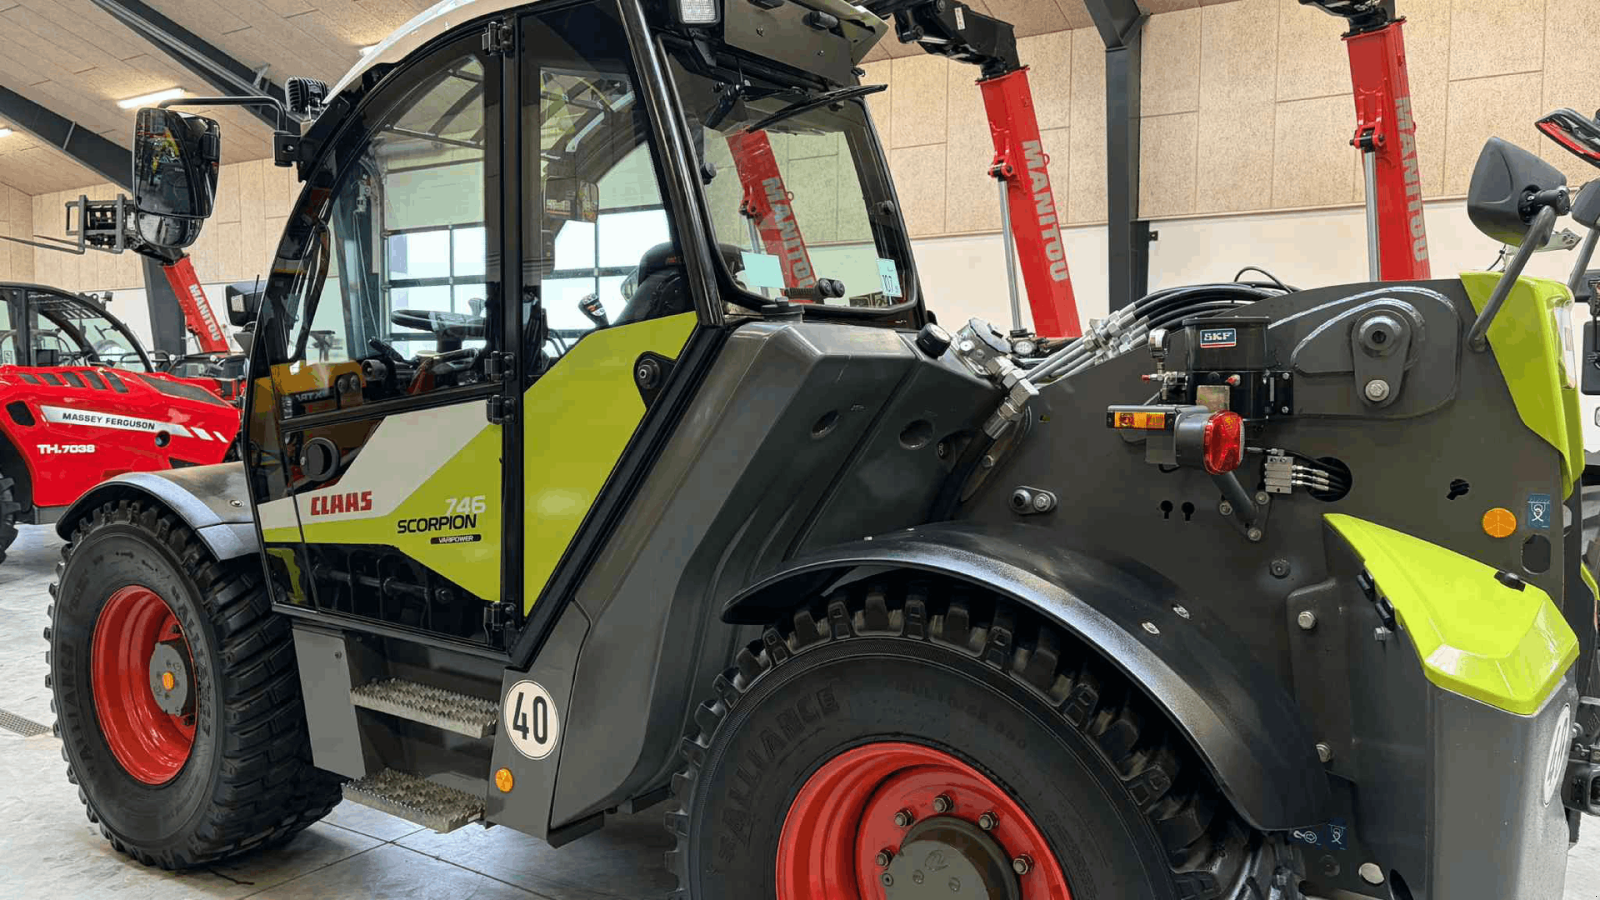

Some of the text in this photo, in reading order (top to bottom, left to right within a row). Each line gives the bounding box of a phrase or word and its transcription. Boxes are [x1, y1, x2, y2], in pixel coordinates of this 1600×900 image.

[1395, 96, 1428, 263] MANITOU
[1022, 139, 1069, 282] MANITOU
[188, 284, 222, 341] MANITOU
[1203, 331, 1233, 341] SKF
[62, 412, 155, 431] MASSEY FERGUSON
[37, 444, 96, 455] TH.7038
[310, 490, 372, 516] CLAAS
[444, 495, 487, 516] 746
[397, 513, 478, 534] SCORPION
[512, 691, 548, 745] 40
[721, 687, 840, 847] ALLIANCE
